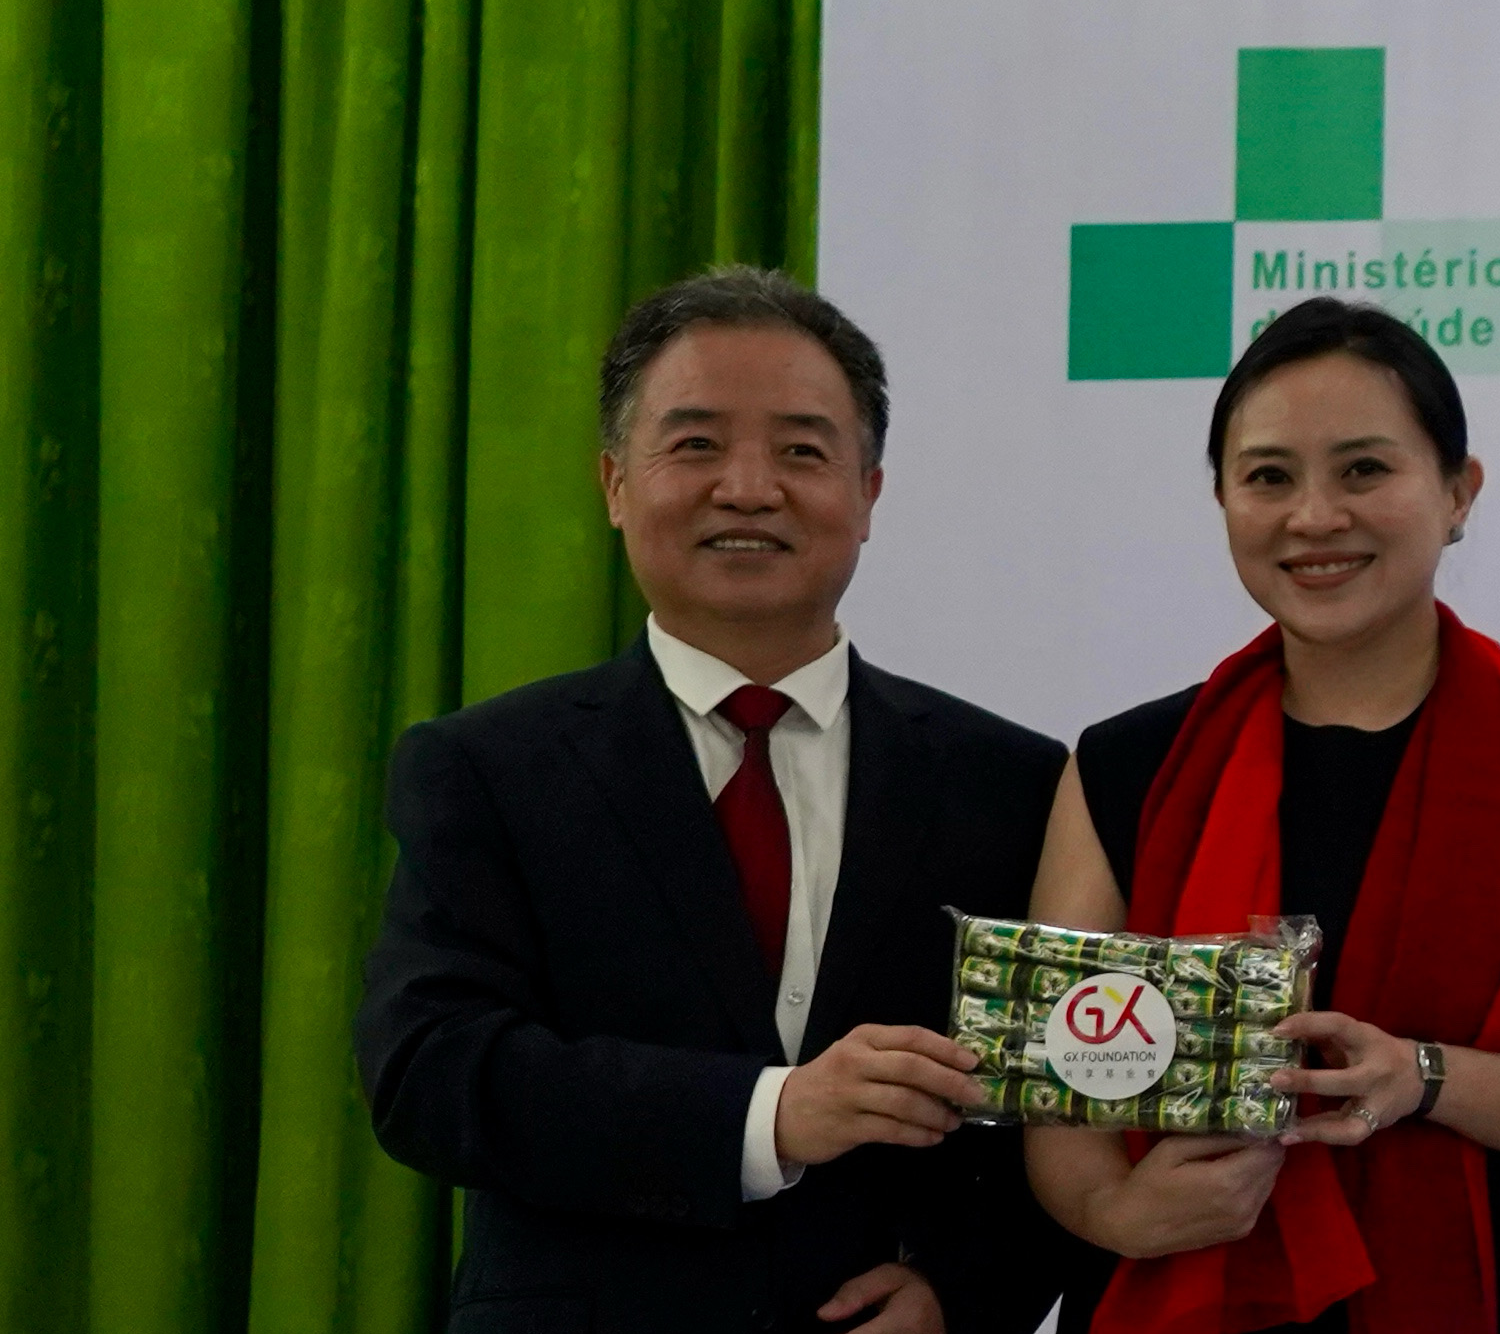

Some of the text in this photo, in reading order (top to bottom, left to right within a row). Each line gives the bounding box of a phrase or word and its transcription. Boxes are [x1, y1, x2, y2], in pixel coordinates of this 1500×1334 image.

[1066, 985, 1156, 1044] GX
[1064, 1051, 1156, 1062] GX FOUNDATION
